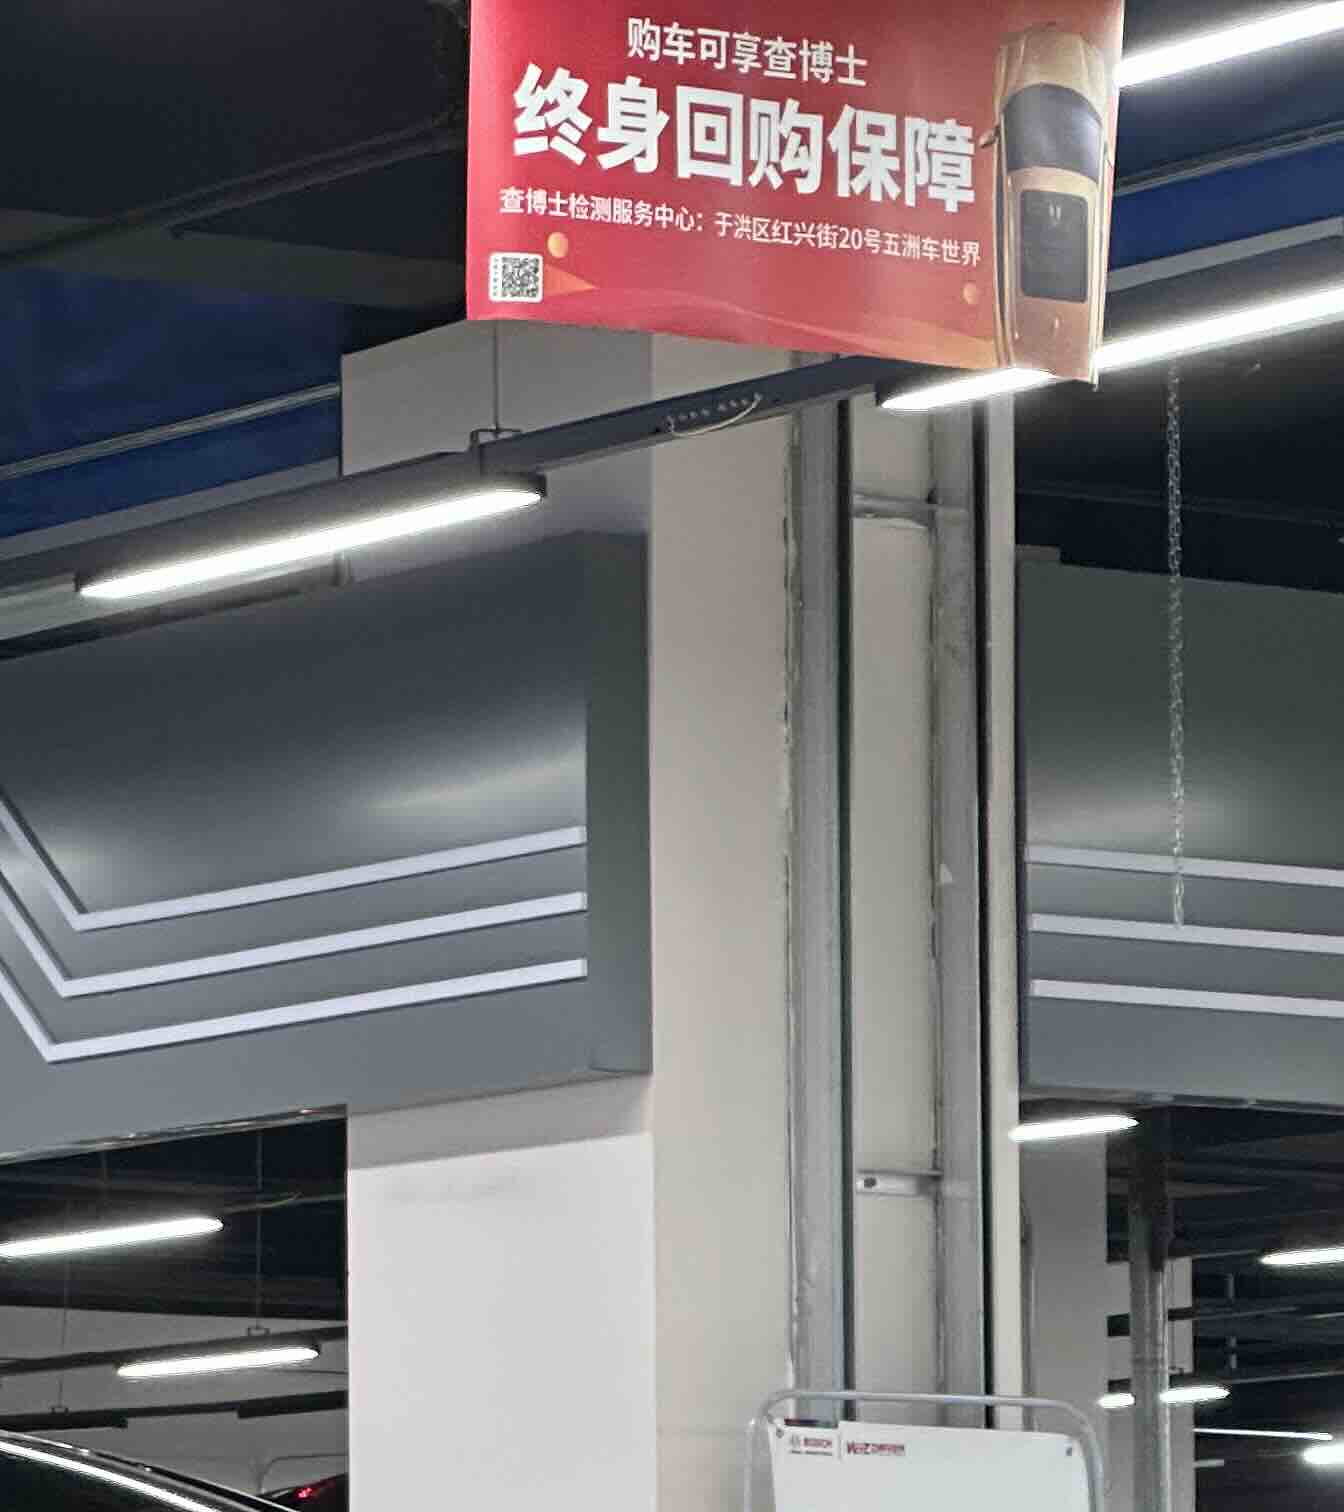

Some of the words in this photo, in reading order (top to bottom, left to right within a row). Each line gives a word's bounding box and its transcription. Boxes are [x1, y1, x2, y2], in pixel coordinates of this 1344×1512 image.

[627, 16, 868, 87] 购车可享查博士
[513, 63, 976, 212] 终身回购保障
